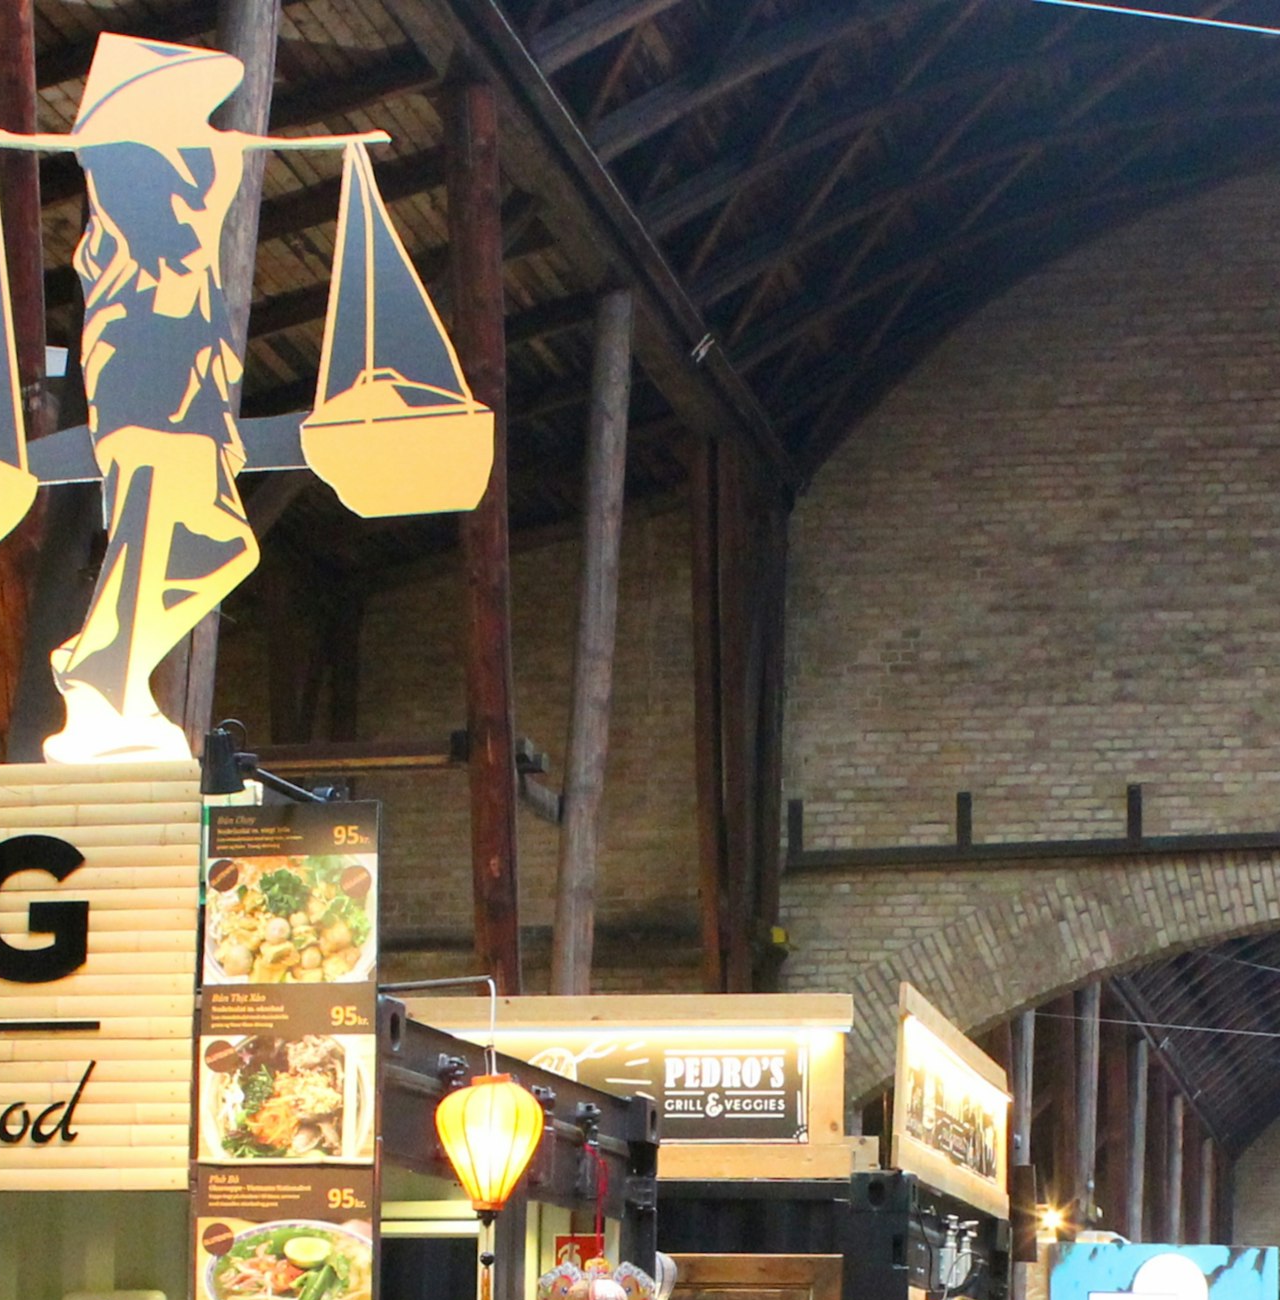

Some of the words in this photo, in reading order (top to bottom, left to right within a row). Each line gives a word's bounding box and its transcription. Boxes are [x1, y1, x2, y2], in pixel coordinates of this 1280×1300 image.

[332, 825, 360, 845] 95
[330, 1006, 358, 1026] 95
[358, 1017, 369, 1026] kr.
[664, 1057, 785, 1088] PEDRO'S
[664, 1099, 703, 1112] GRILL
[705, 1093, 724, 1118] &
[725, 1099, 785, 1112] VEGGIES
[327, 1188, 354, 1208] 95
[355, 1199, 367, 1208] kr.
